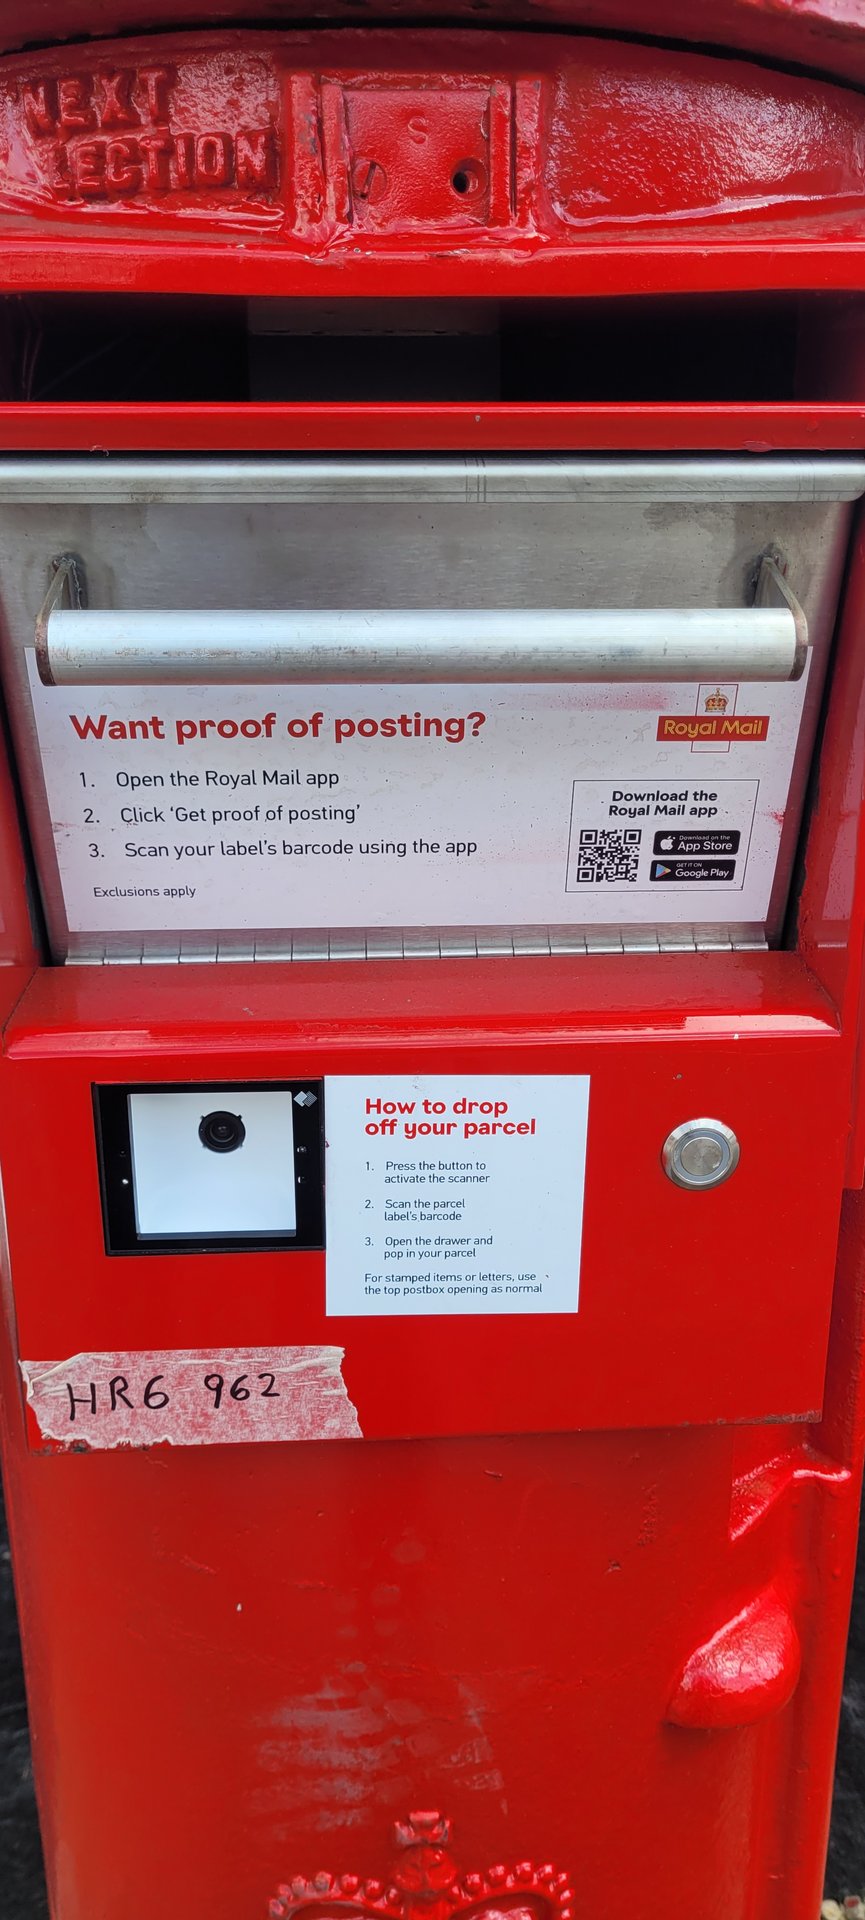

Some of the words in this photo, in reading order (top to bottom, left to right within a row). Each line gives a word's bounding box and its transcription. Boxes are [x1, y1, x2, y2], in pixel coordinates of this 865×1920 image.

[24, 68, 168, 130] NEXT
[407, 116, 430, 146] S
[69, 715, 165, 740] Want
[176, 713, 276, 744] proof
[287, 712, 322, 738] of
[335, 711, 486, 743] posting?
[664, 720, 716, 738] Royal
[721, 720, 762, 735] Mail
[80, 773, 95, 788] 1.
[116, 772, 164, 791] Open
[170, 771, 199, 787] the
[206, 771, 257, 790] Royal
[263, 770, 300, 786] Mail
[306, 774, 339, 791] app
[612, 791, 688, 802] Download
[693, 791, 717, 801] the
[84, 809, 100, 824] 2.
[121, 807, 164, 824] Click
[212, 805, 260, 825] proof
[266, 806, 284, 821] of
[609, 805, 649, 818] Royal
[654, 805, 685, 816] Mail
[690, 807, 717, 818] app
[89, 843, 105, 858] 3.
[125, 842, 169, 858] Scan
[174, 844, 215, 861] your
[283, 839, 353, 856] barcode
[359, 840, 406, 858] using
[413, 839, 440, 854] the
[445, 841, 477, 857] app
[678, 841, 700, 852] App
[703, 841, 732, 850] Store
[675, 869, 708, 878] Google
[710, 868, 729, 878] Play
[94, 886, 159, 898] Exclusions
[164, 885, 196, 899] apply
[365, 1098, 416, 1115] How
[423, 1099, 446, 1114] to
[453, 1098, 508, 1118] drop
[365, 1119, 398, 1136] off
[404, 1122, 457, 1139] your
[464, 1119, 536, 1138] parcel
[366, 1162, 374, 1171] 1.
[386, 1161, 416, 1171] Press
[419, 1161, 436, 1170] the
[438, 1161, 473, 1170] button
[476, 1162, 486, 1170] to
[385, 1174, 425, 1183] activate
[429, 1174, 445, 1183] the
[448, 1175, 490, 1183] scanner
[365, 1200, 374, 1209] 2.
[385, 1200, 411, 1209] Scan
[414, 1199, 430, 1208] the
[433, 1199, 465, 1210] parcel
[420, 1212, 462, 1221] barcode
[365, 1238, 374, 1246] 3.
[385, 1237, 412, 1248] Open
[415, 1237, 431, 1246] the
[434, 1236, 471, 1246] drawer
[474, 1236, 493, 1245] and
[384, 1250, 403, 1260] pop
[407, 1249, 415, 1258] in
[418, 1250, 442, 1260] your
[444, 1248, 476, 1259] parcel
[365, 1274, 383, 1282] For
[385, 1273, 430, 1284] stamped
[433, 1273, 462, 1282] items
[479, 1272, 515, 1283] letters,
[518, 1273, 536, 1281] use
[365, 1286, 381, 1295] the
[384, 1286, 400, 1296] top
[403, 1285, 444, 1295] postbox
[447, 1285, 488, 1295] opening
[506, 1284, 542, 1293] normal
[67, 1375, 170, 1421] HR6
[204, 1373, 280, 1408] 962
